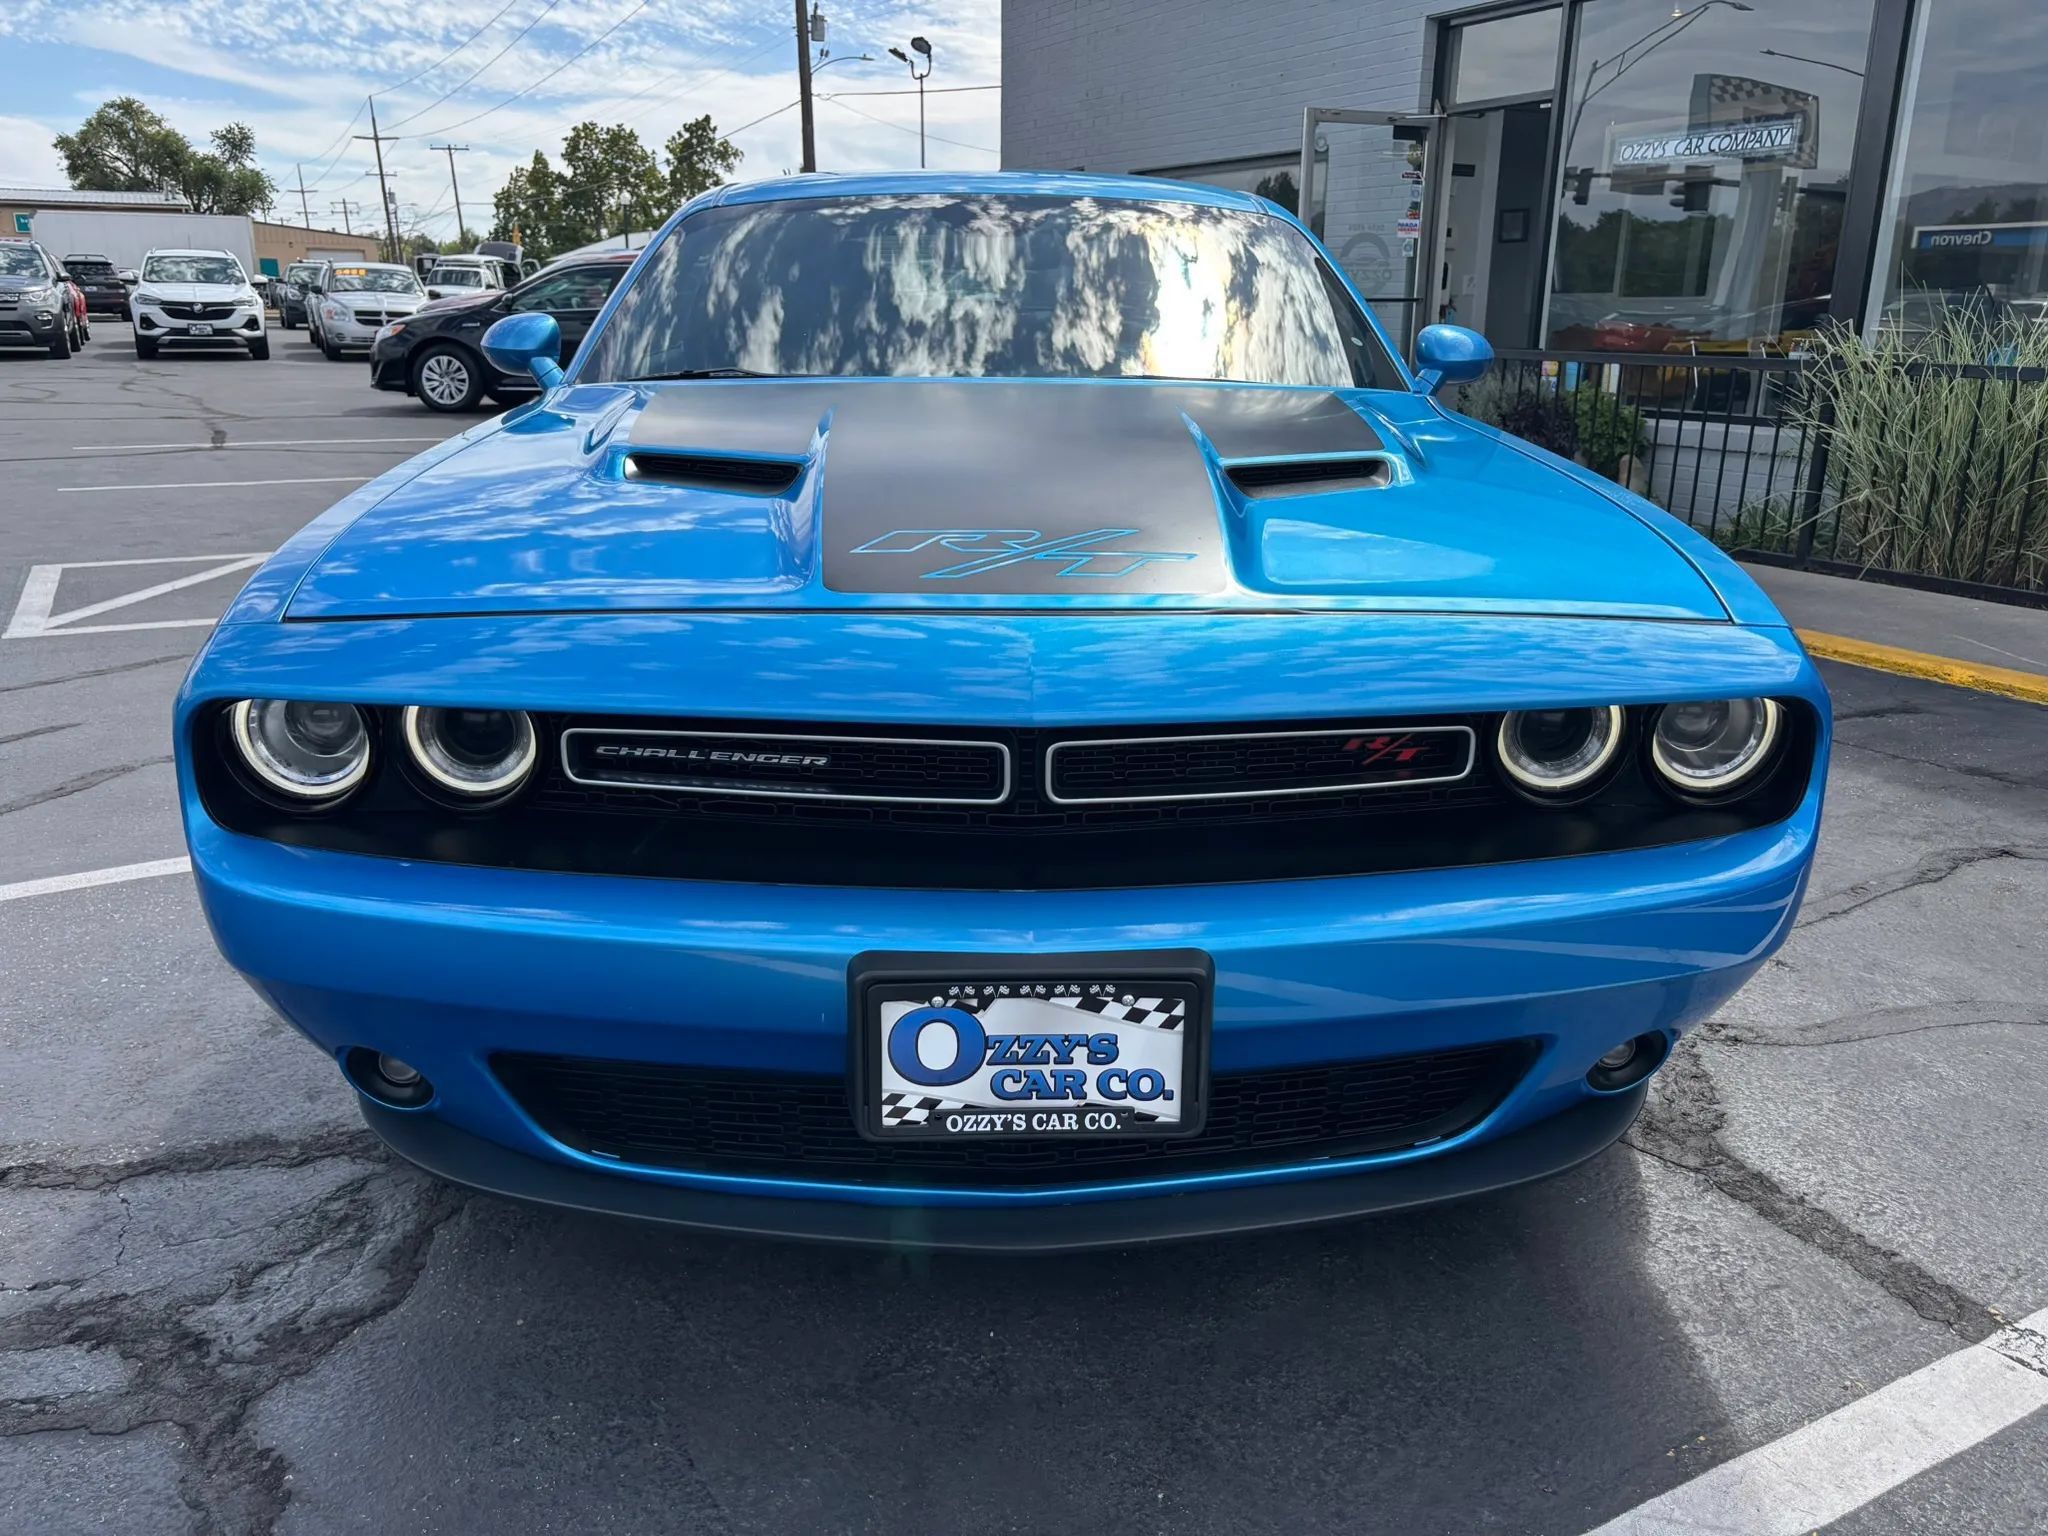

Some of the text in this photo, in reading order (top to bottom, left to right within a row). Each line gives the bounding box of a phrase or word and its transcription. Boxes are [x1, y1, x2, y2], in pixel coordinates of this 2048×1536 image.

[1620, 127, 1792, 161] OZZY'S CAR COMPANY
[850, 529, 1198, 578] R/T
[596, 745, 829, 767] CHALLENGER
[1341, 732, 1433, 765] R/T
[887, 1006, 1120, 1087] OZZY'S
[990, 1068, 1175, 1101] CAR CO.
[945, 1111, 1122, 1133] OZZY'S CAR CO.
